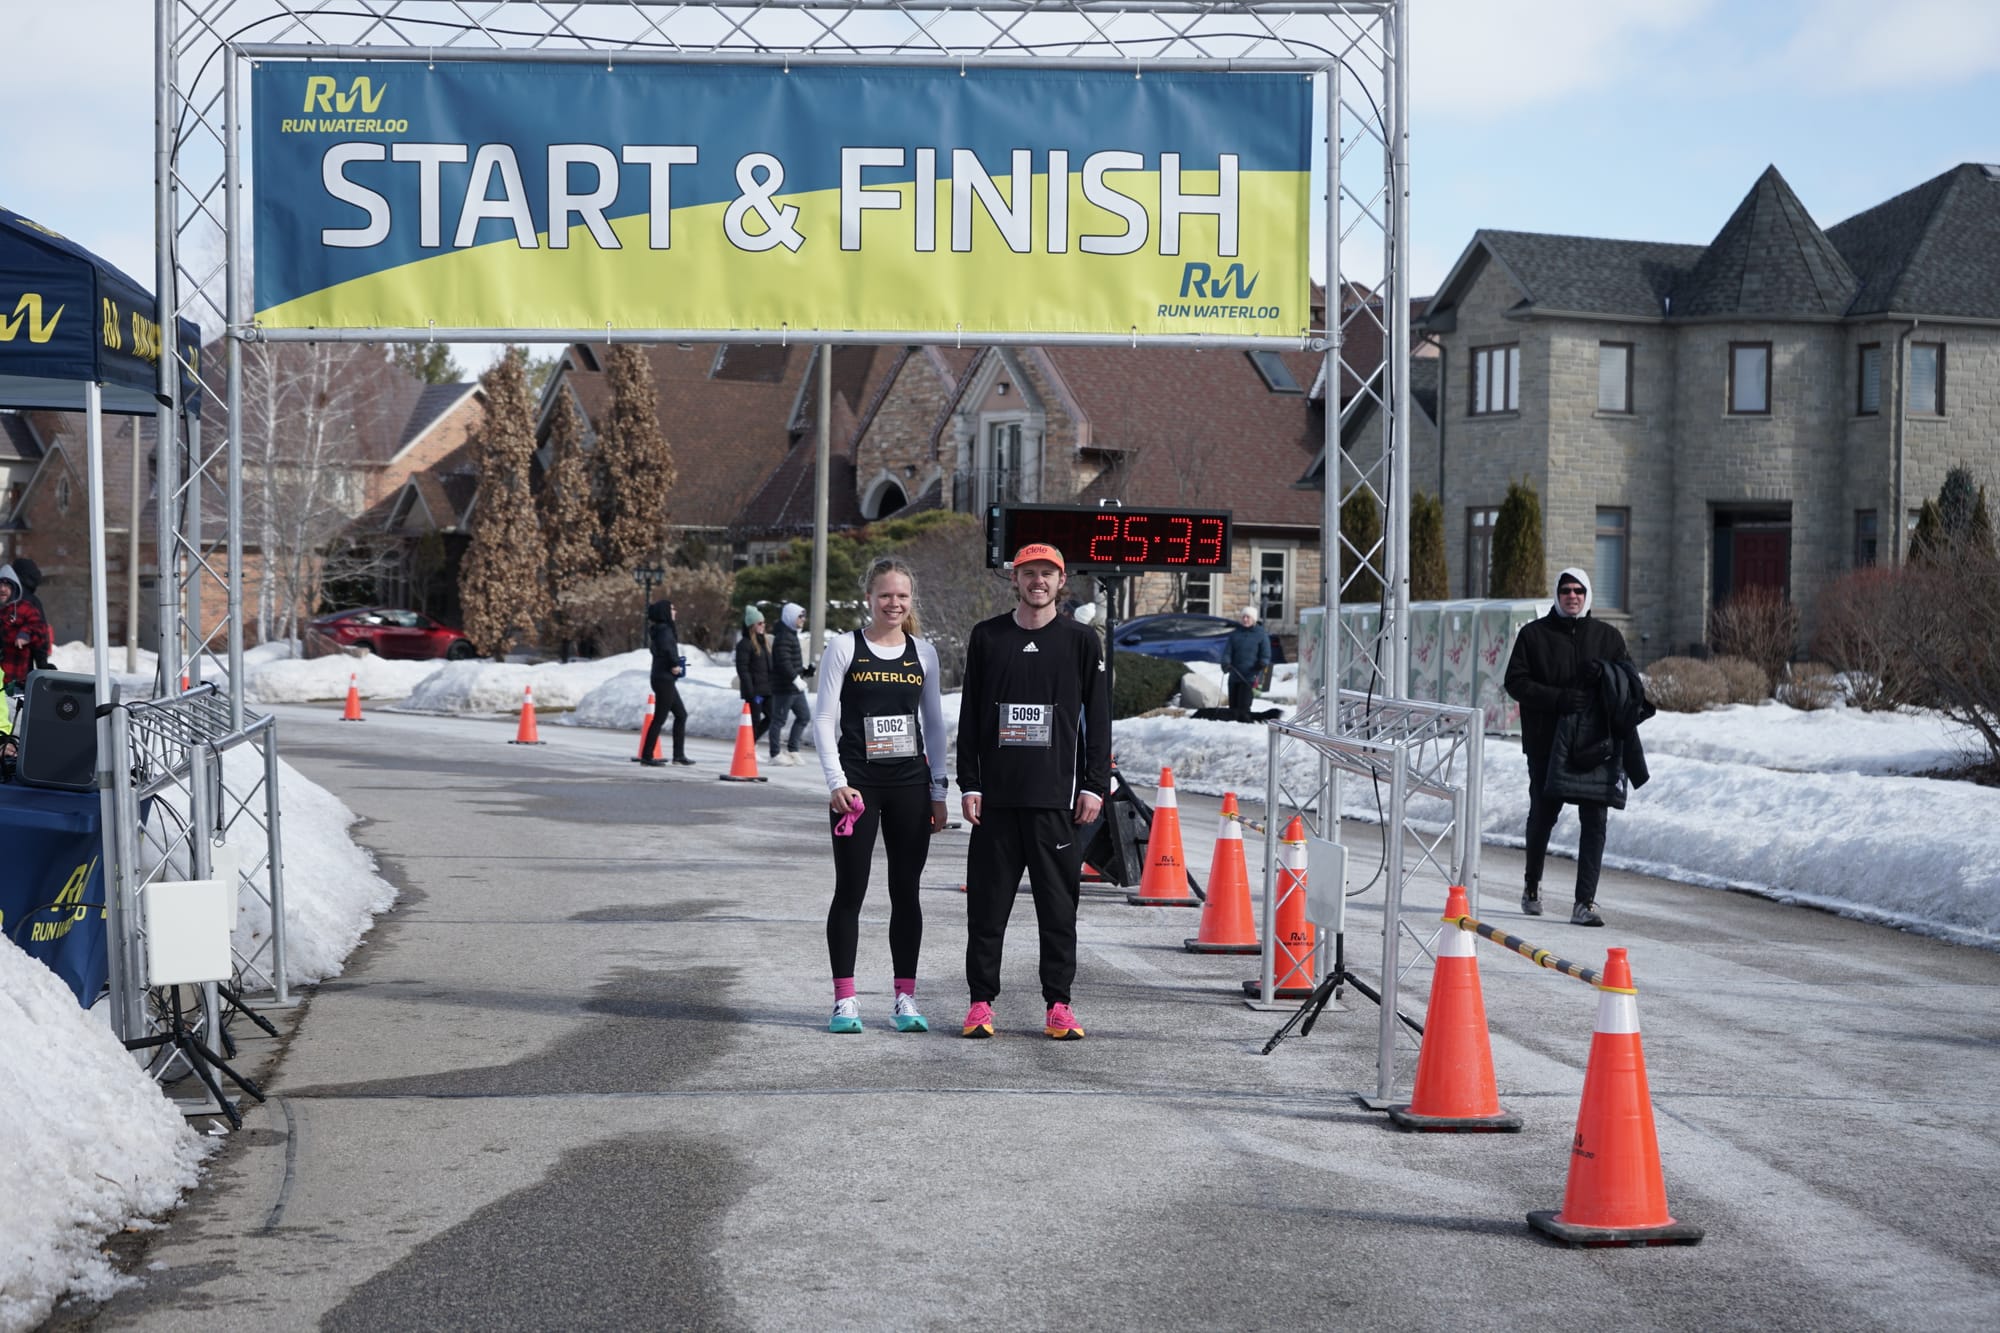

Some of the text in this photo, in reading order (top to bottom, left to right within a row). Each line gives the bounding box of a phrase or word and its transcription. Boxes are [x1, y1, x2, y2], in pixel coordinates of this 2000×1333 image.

[281, 119, 408, 133] RUN WATERLOO
[321, 142, 1240, 257] START & FINISH
[1157, 304, 1279, 319] RUN WATERLOO
[851, 671, 922, 686] WATERLOO
[1012, 707, 1041, 721] 5099
[876, 718, 904, 733] 5062
[31, 921, 58, 942] RUN
